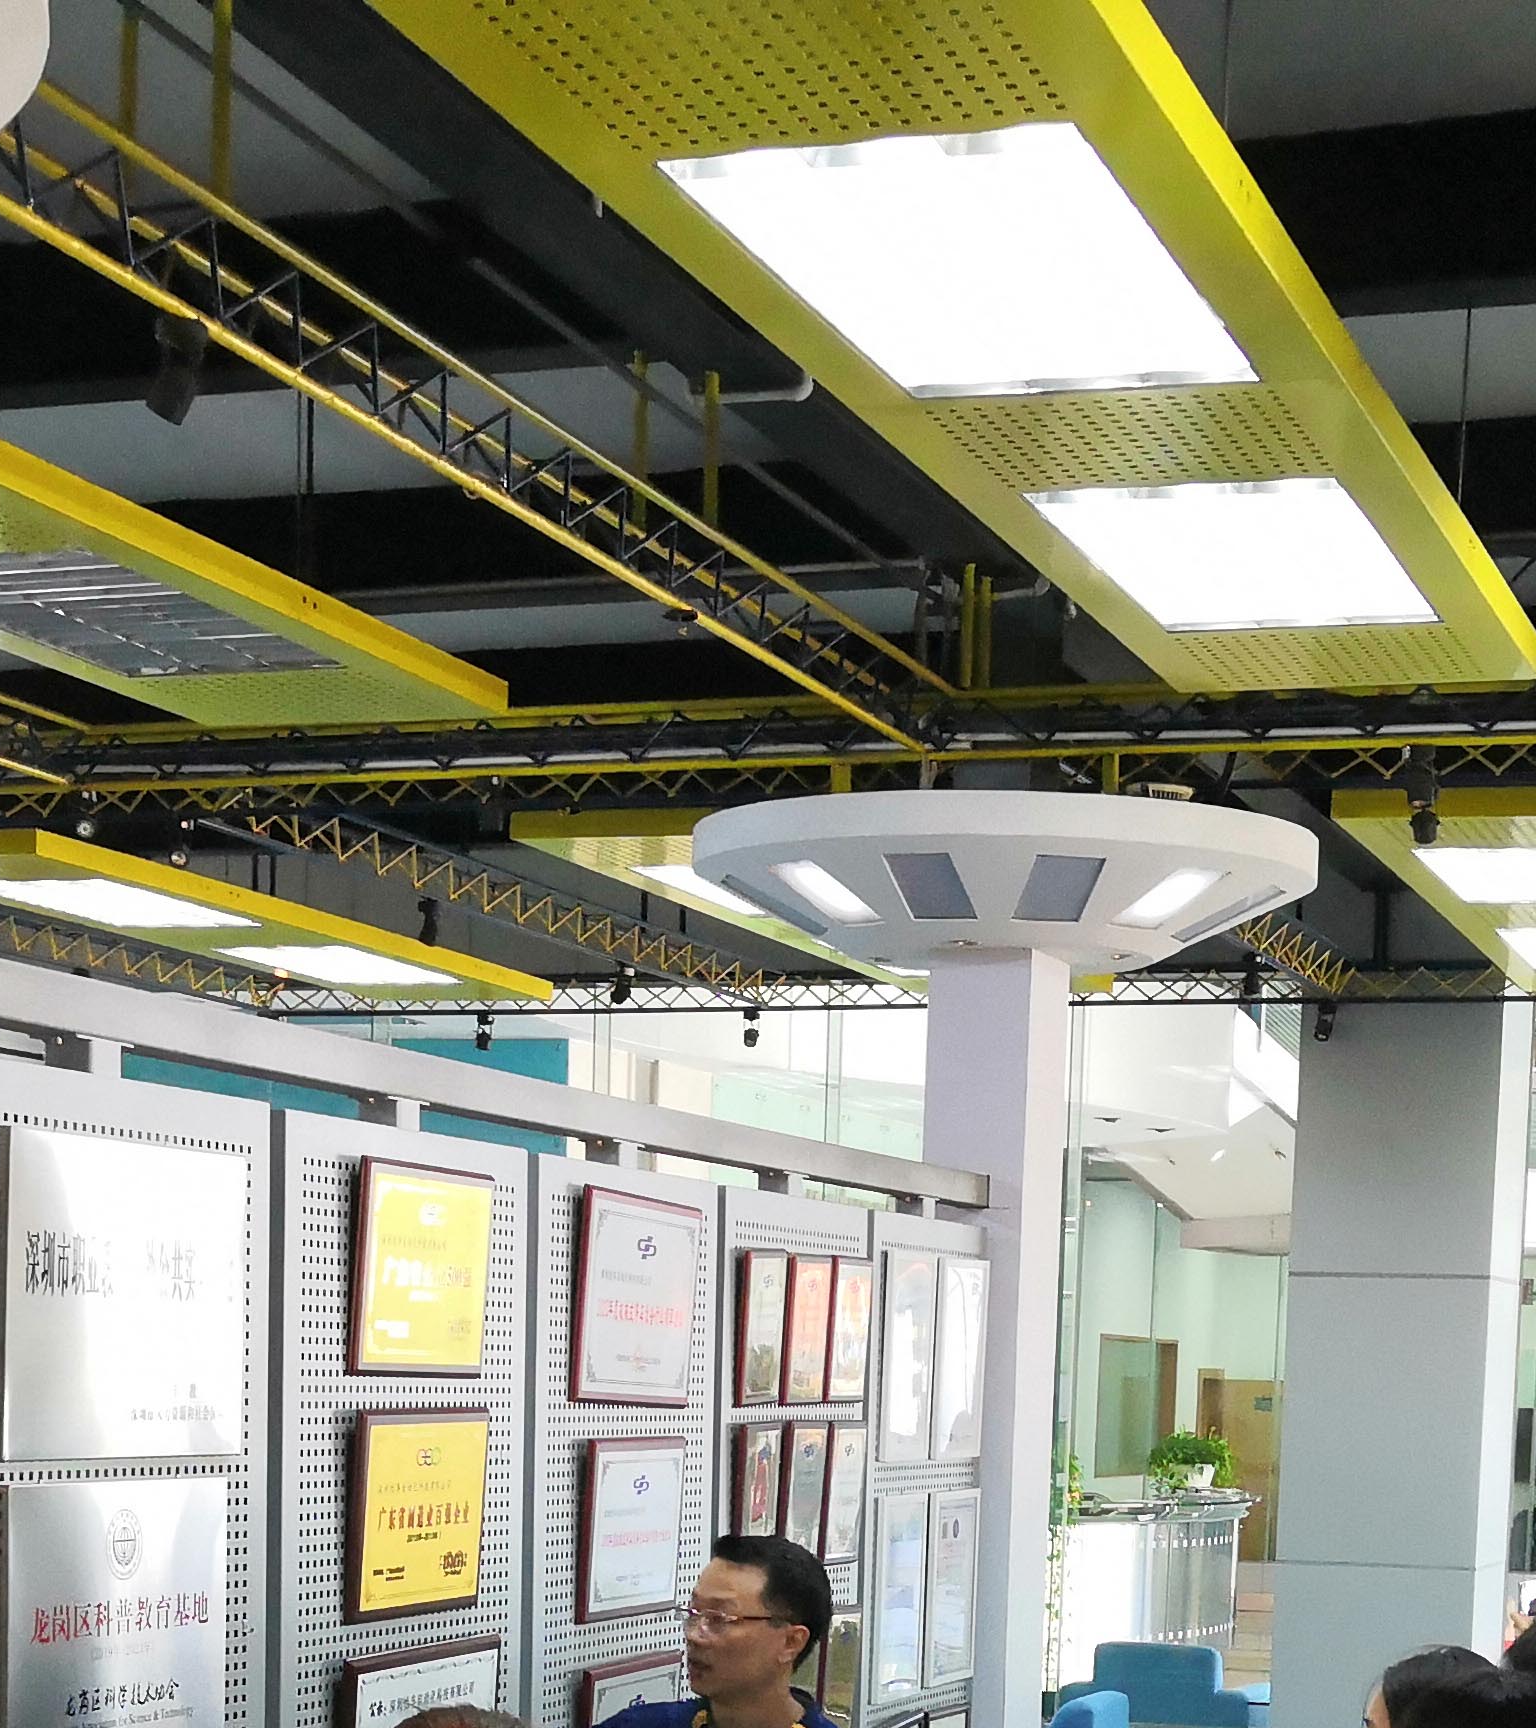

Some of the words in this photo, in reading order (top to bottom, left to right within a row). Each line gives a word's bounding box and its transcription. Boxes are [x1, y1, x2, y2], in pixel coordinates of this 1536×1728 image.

[30, 1590, 209, 1645] 龙岗区科普教育基地
